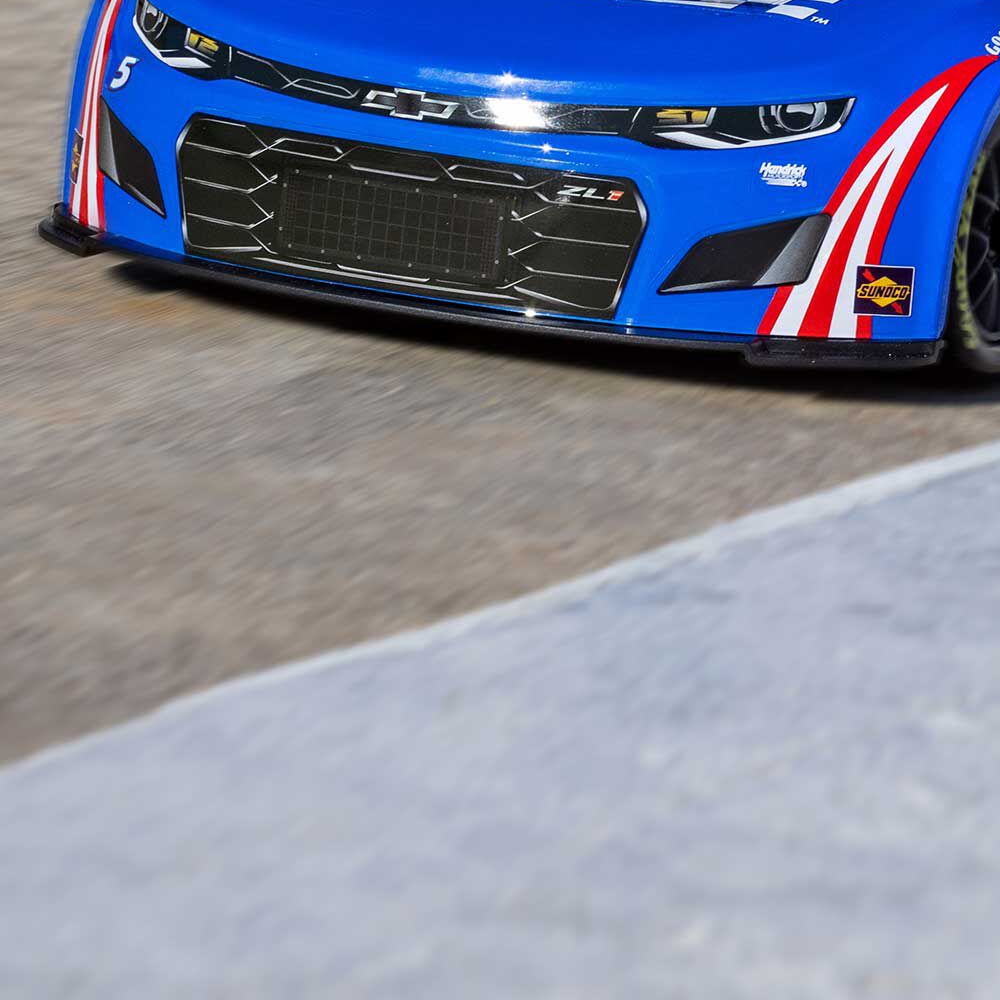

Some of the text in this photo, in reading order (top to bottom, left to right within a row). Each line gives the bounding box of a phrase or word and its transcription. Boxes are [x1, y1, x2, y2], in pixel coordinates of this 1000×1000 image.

[108, 55, 141, 92] 5
[759, 161, 808, 178] Hendrick
[556, 184, 625, 201] ZL1
[858, 284, 911, 300] SUNOCO
